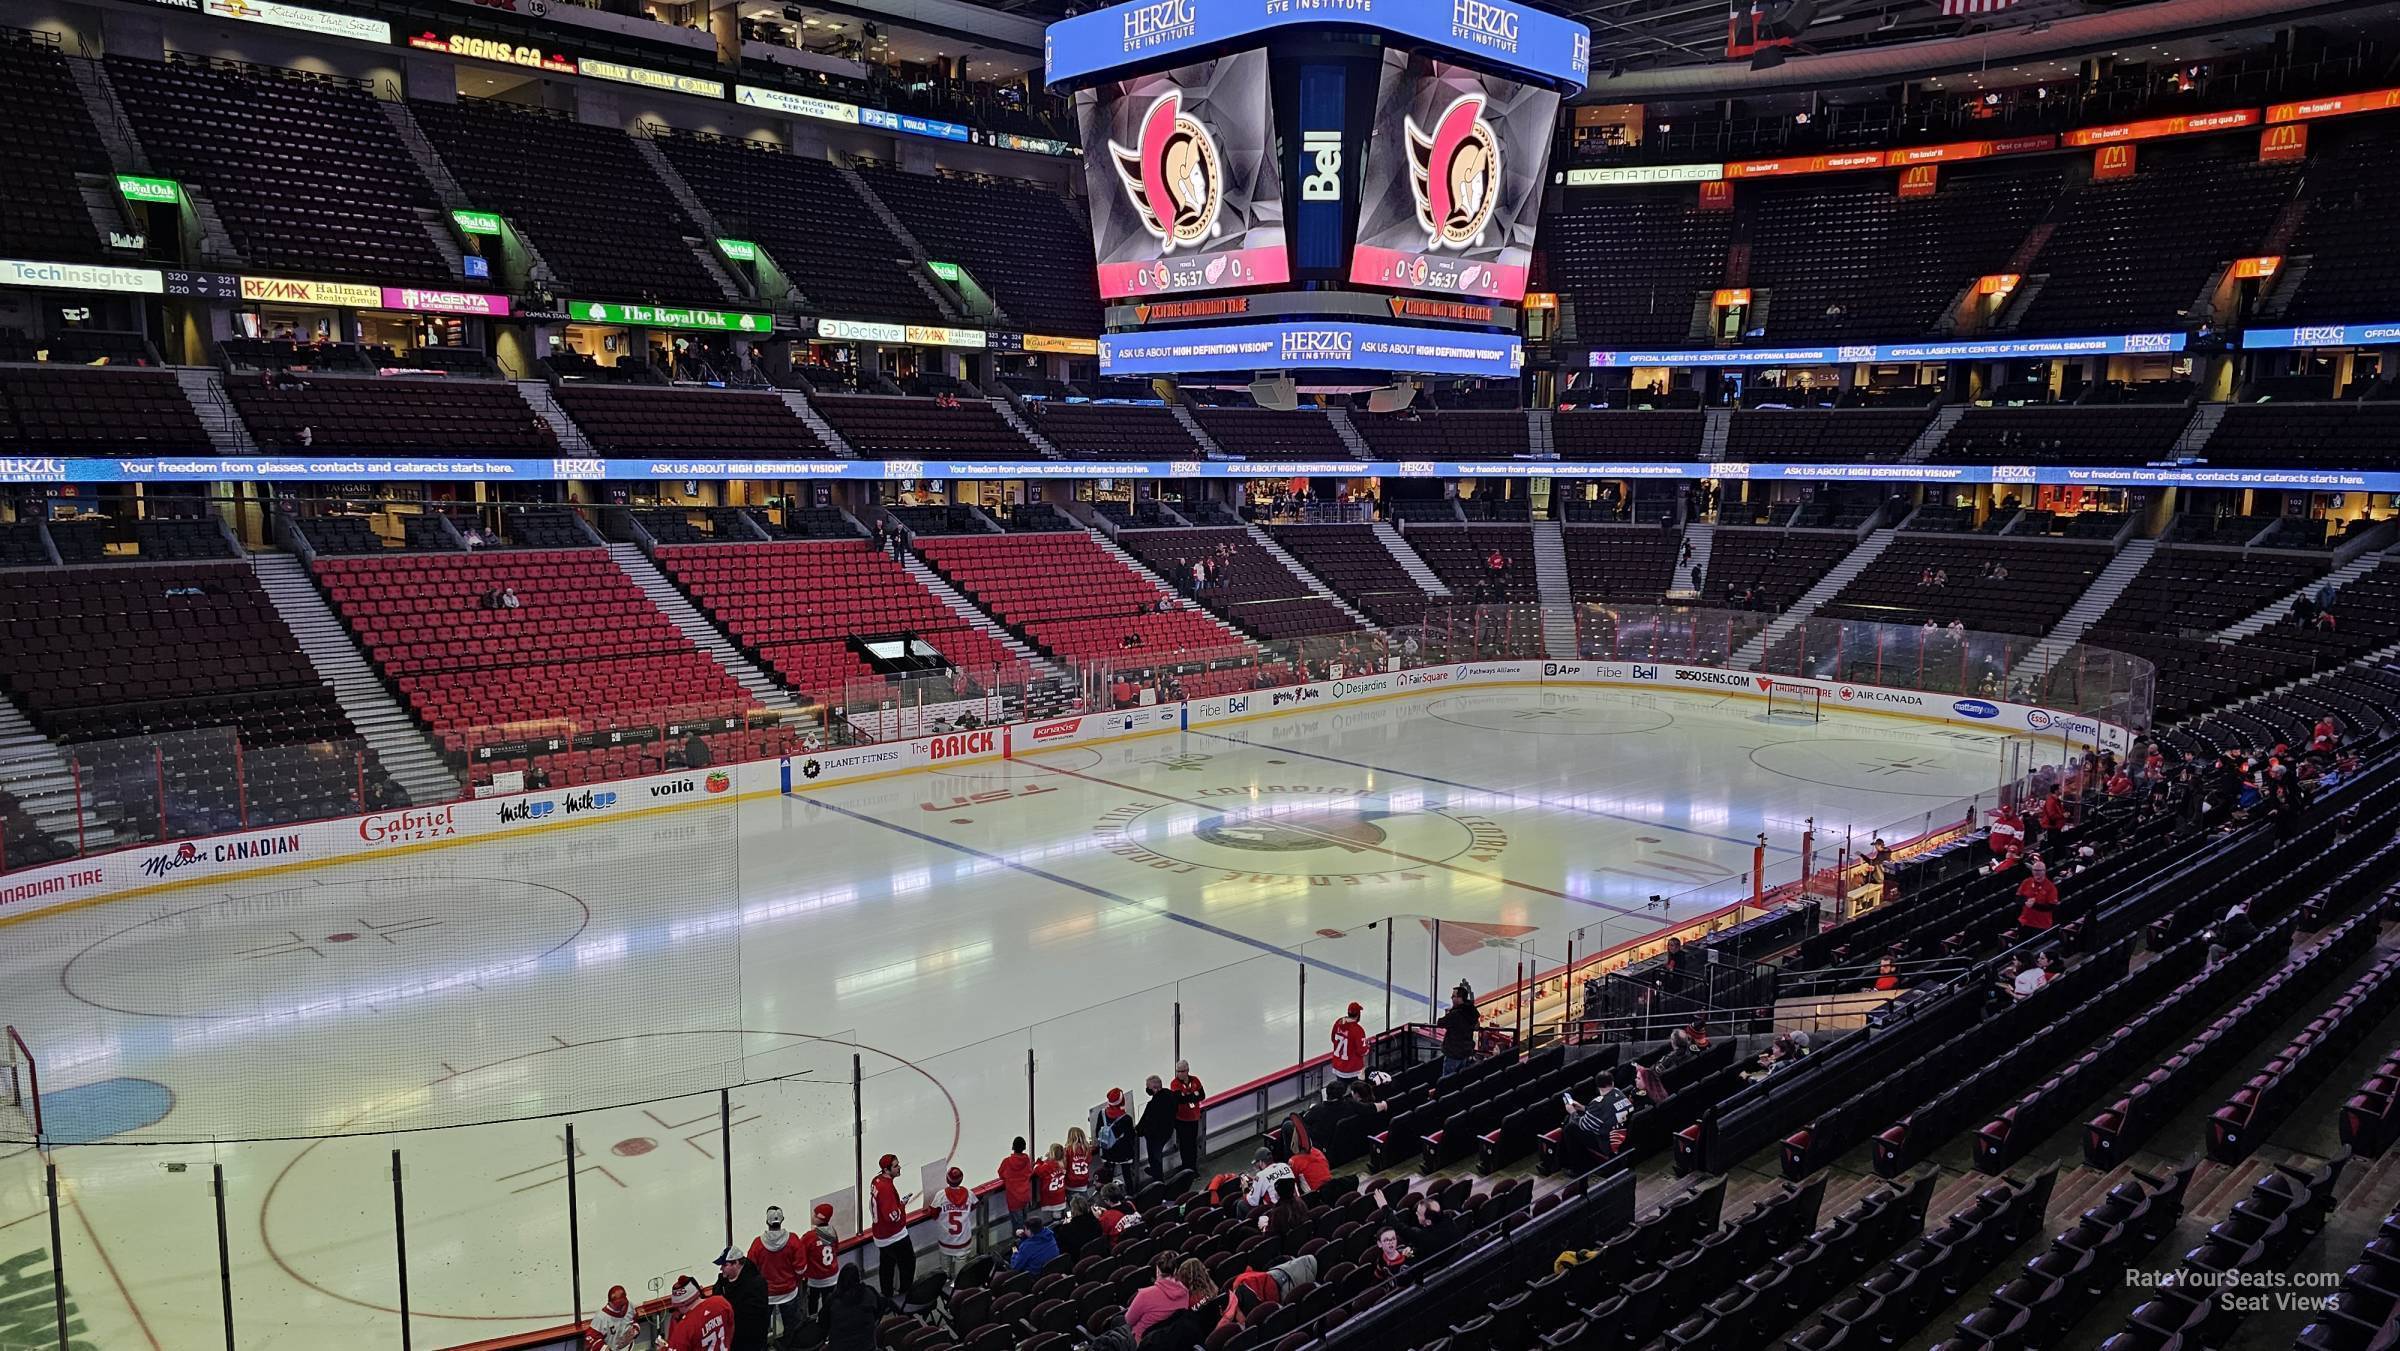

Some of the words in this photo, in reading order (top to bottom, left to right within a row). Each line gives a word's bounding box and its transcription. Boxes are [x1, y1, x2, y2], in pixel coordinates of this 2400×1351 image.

[530, 1, 543, 12] 18
[1124, 0, 1195, 38] HERZIG
[1453, 0, 1519, 40] HERZIG
[1124, 41, 1141, 52] EYE
[1145, 24, 1195, 46] INSTITUTE
[1453, 26, 1469, 39] EYE
[1473, 31, 1517, 53] INSTITUTE
[450, 35, 541, 67] SIGNS.CA
[766, 92, 799, 105] ACCESS
[801, 98, 840, 111] RIGGING
[782, 102, 824, 116] SERVICES
[1303, 132, 1341, 200] Bell
[1571, 167, 1720, 183] LIVENATION.com
[12, 263, 143, 287] TechInsights
[168, 272, 188, 282] 320
[217, 275, 236, 285] 321
[1138, 268, 1147, 286] 0
[1173, 270, 1203, 288] 56:37
[1231, 259, 1241, 277] 0
[1396, 260, 1405, 278] 0
[1429, 271, 1458, 289] 56:37
[1482, 271, 1491, 288] 0
[169, 285, 190, 295] 220
[218, 288, 237, 297] 221
[245, 280, 310, 299] RE/MAX
[315, 283, 378, 297] Hallmark
[316, 293, 349, 305] Realty
[351, 296, 378, 307] Group
[420, 293, 489, 307] MAGENTA
[525, 311, 548, 319] CAMERA
[549, 312, 571, 320] STAND
[621, 305, 652, 320] The
[654, 308, 695, 327] Royal
[698, 310, 726, 326] Oak
[839, 321, 901, 340] Decisive
[908, 326, 945, 342] RE/MAX
[2294, 325, 2345, 340] HERZIG
[1281, 330, 1352, 351] HERZIG
[1891, 348, 1925, 356] OFFICIAL
[1926, 347, 1950, 355] LASER
[1968, 345, 1998, 354] CENTRE
[2012, 344, 2028, 352] THE
[2029, 343, 2063, 351] OTTAWA
[2064, 341, 2108, 350] SENATORS
[2126, 334, 2171, 348] HERZIG
[1119, 349, 1133, 358] ASK
[1134, 348, 1144, 357] US
[1146, 347, 1172, 357] ABOUT
[1173, 346, 1192, 356] HIGH
[1193, 344, 1238, 355] DEFINITION
[1302, 352, 1352, 360] INSTITUTE
[1361, 342, 1376, 352] ASK
[1378, 343, 1388, 353] US
[1389, 344, 1415, 354] ABOUT
[1416, 346, 1435, 356] HIGH
[1838, 346, 1877, 357] HERZIG
[120, 462, 155, 472] Your
[158, 462, 217, 472] freedom
[221, 462, 254, 472] from
[257, 462, 308, 474] glasses,
[310, 462, 365, 472] contacts
[368, 462, 391, 472] and
[394, 463, 449, 472] cataracts
[452, 463, 484, 472] starts
[486, 463, 514, 472] here.
[554, 459, 606, 472] HERZIG
[884, 462, 923, 473] HERZIG
[1711, 463, 1750, 473] HERZIG
[1992, 466, 2036, 477] HERZIG
[1409, 671, 1448, 686] FairSquare
[1468, 667, 1496, 677] Pathways
[1497, 666, 1520, 675] Alliance
[1596, 666, 1622, 678] Fibe
[1632, 665, 1658, 680] Bell
[1675, 669, 1750, 688] 5050SENS.COM
[1346, 679, 1387, 696] Desjardins
[1229, 696, 1249, 713] Bell
[1856, 690, 1875, 700] AIR
[1876, 692, 1923, 705] CANADA
[911, 742, 928, 756] The
[930, 731, 992, 760] BRICK
[825, 757, 860, 770] PLANET
[862, 751, 899, 764] FITNESS
[651, 778, 694, 797] voilà
[359, 805, 455, 841] Gabriel
[390, 826, 456, 843] PIZZA
[140, 848, 208, 878] Molson
[215, 834, 300, 863] CANADIAN
[68, 868, 103, 889] TIRE
[1333, 1035, 1349, 1061] 71
[948, 1212, 963, 1236] 5
[821, 1245, 833, 1267] 8
